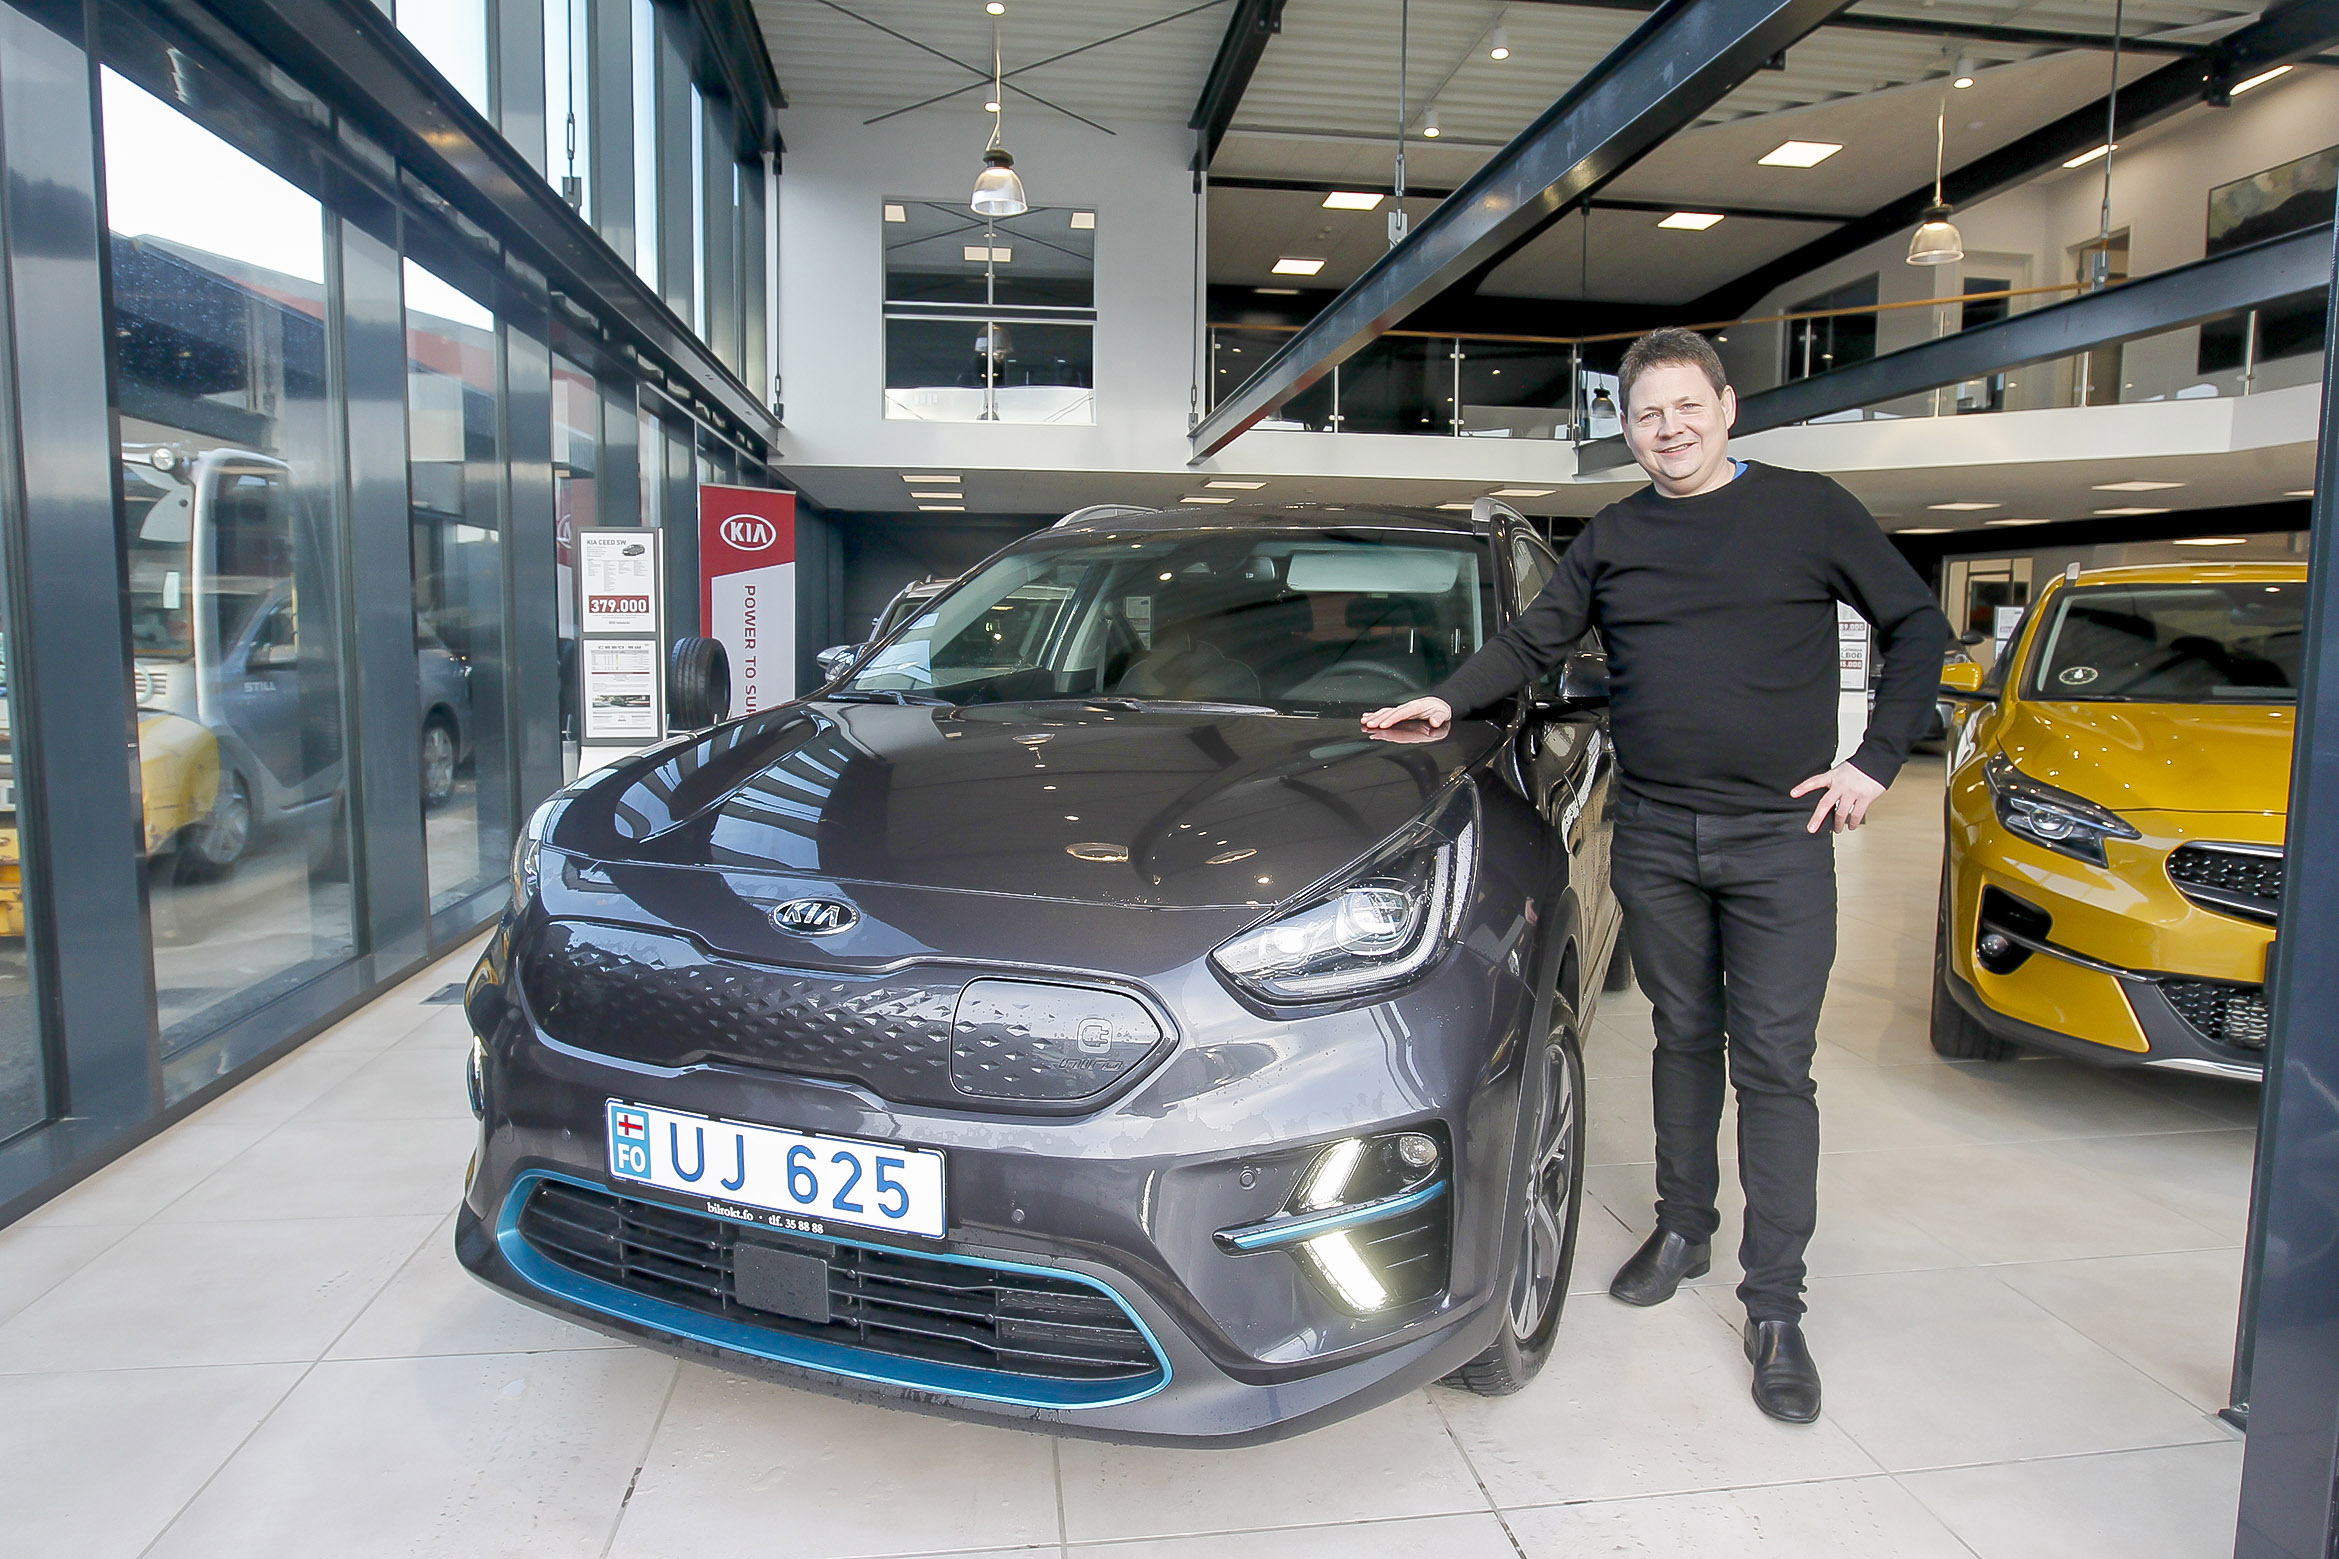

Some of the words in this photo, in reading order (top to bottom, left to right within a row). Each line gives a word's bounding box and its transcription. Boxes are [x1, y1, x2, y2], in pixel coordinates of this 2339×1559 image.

[730, 521, 767, 543] KIA
[590, 599, 647, 613] 379.000
[744, 585, 756, 649] POWER
[745, 655, 756, 678] TO
[244, 681, 276, 692] STILL
[782, 902, 840, 927] KIA
[617, 1142, 647, 1173] FO
[670, 1121, 744, 1191] UJ
[787, 1144, 909, 1219] 625
[706, 1201, 754, 1221] bilrokt.fo
[768, 1214, 783, 1227] tlf.
[785, 1218, 796, 1230] 35
[798, 1220, 810, 1232] 88
[811, 1223, 824, 1234] 88
